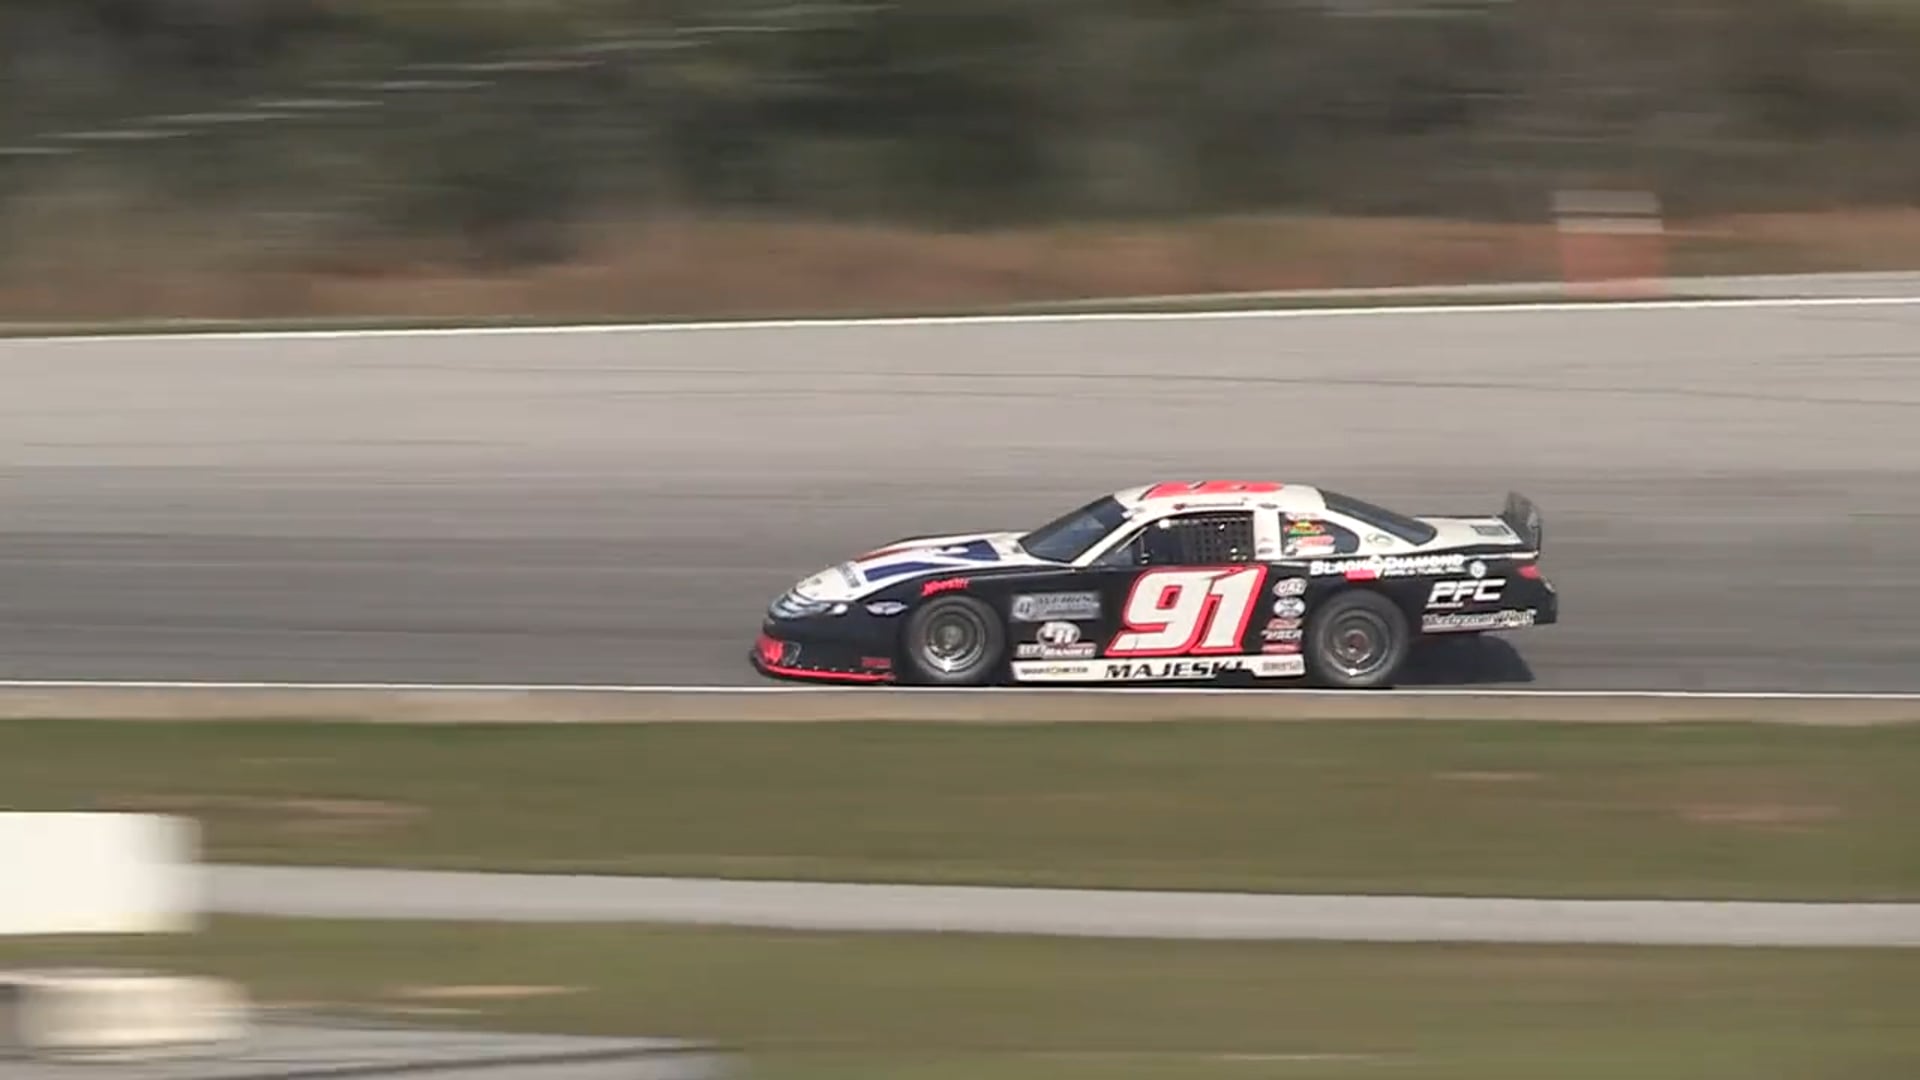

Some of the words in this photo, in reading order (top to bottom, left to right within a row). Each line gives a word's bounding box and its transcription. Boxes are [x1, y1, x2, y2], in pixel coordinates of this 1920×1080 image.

[1384, 554, 1465, 569] DIAMOND
[1427, 578, 1506, 603] PFC
[1104, 564, 1268, 657] 91
[1104, 661, 1244, 679] MAJESKI
